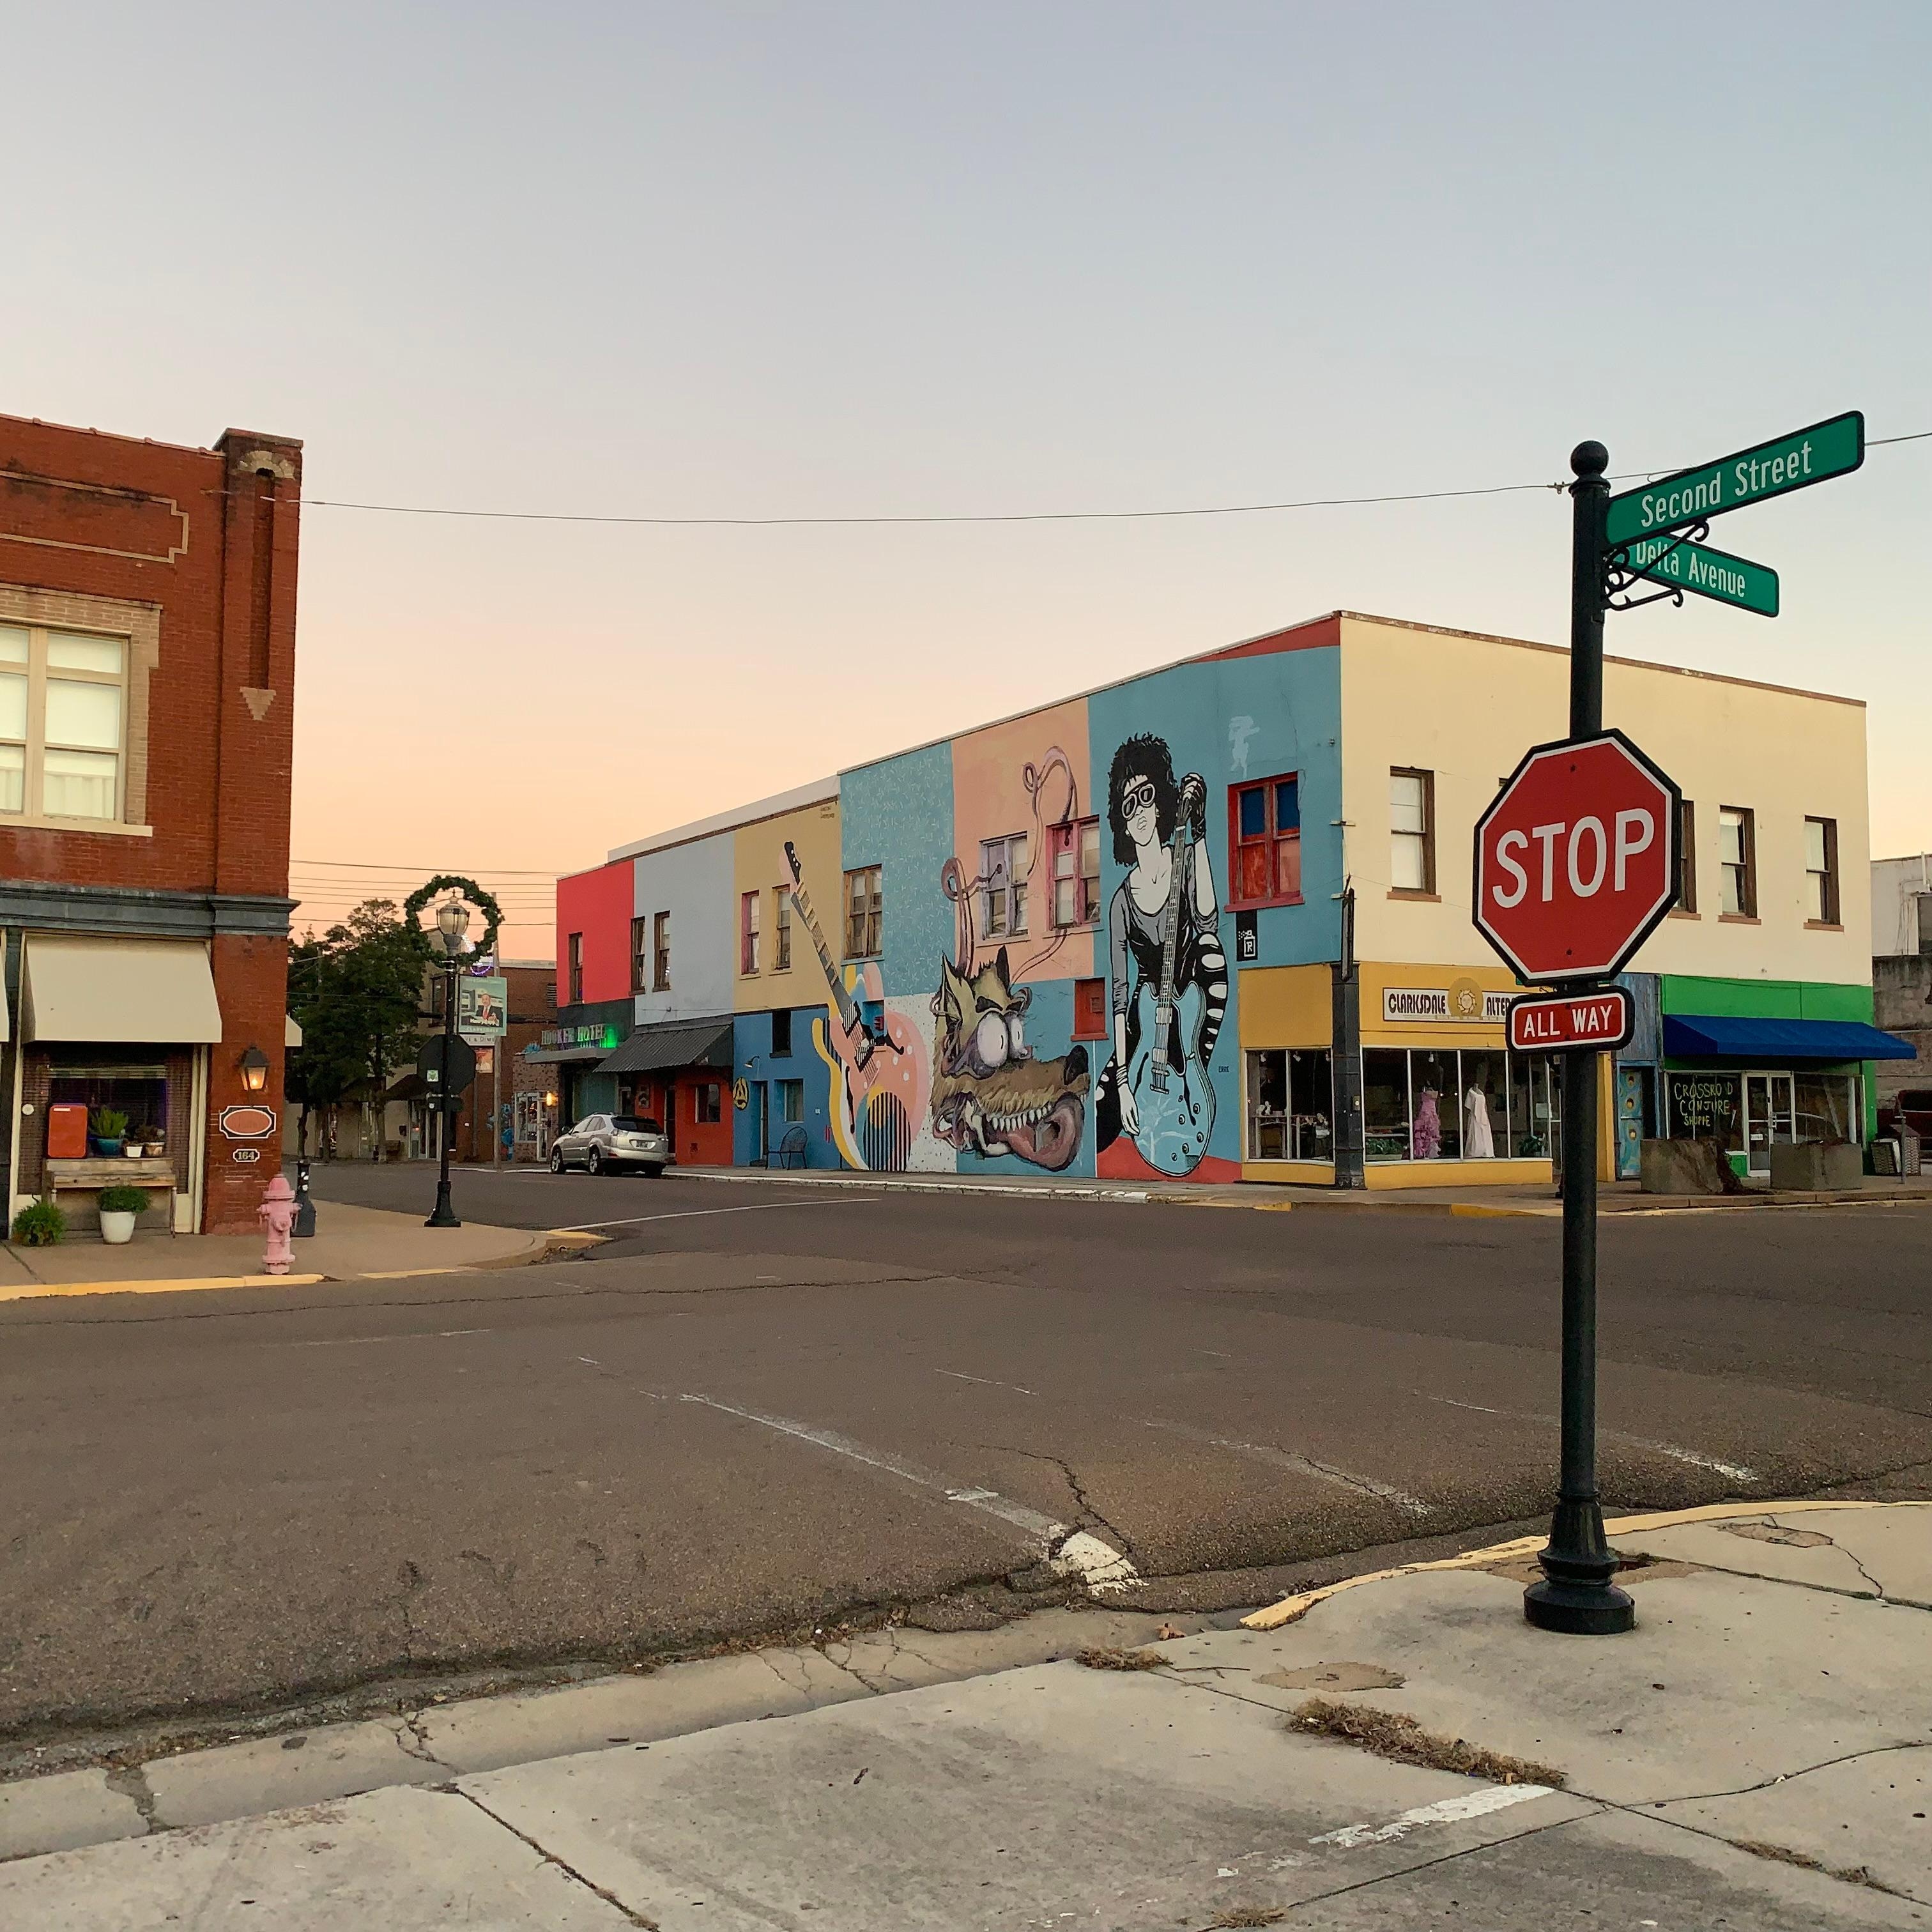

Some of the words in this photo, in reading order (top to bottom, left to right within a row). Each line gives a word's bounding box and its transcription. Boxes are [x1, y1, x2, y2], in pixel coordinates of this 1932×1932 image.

[1641, 471, 1721, 527] Second
[1735, 440, 1812, 496] Street
[1636, 541, 1679, 576] Delta
[1689, 552, 1745, 597] Avenue
[1492, 808, 1655, 908] STOP
[1388, 993, 1446, 1015] CLARKSDALE
[1486, 996, 1513, 1016] ALTER
[1523, 1011, 1561, 1038] ALL
[1572, 1005, 1613, 1034] WAY
[1680, 1100, 1731, 1116] CONJURE
[238, 1151, 255, 1160] 164
